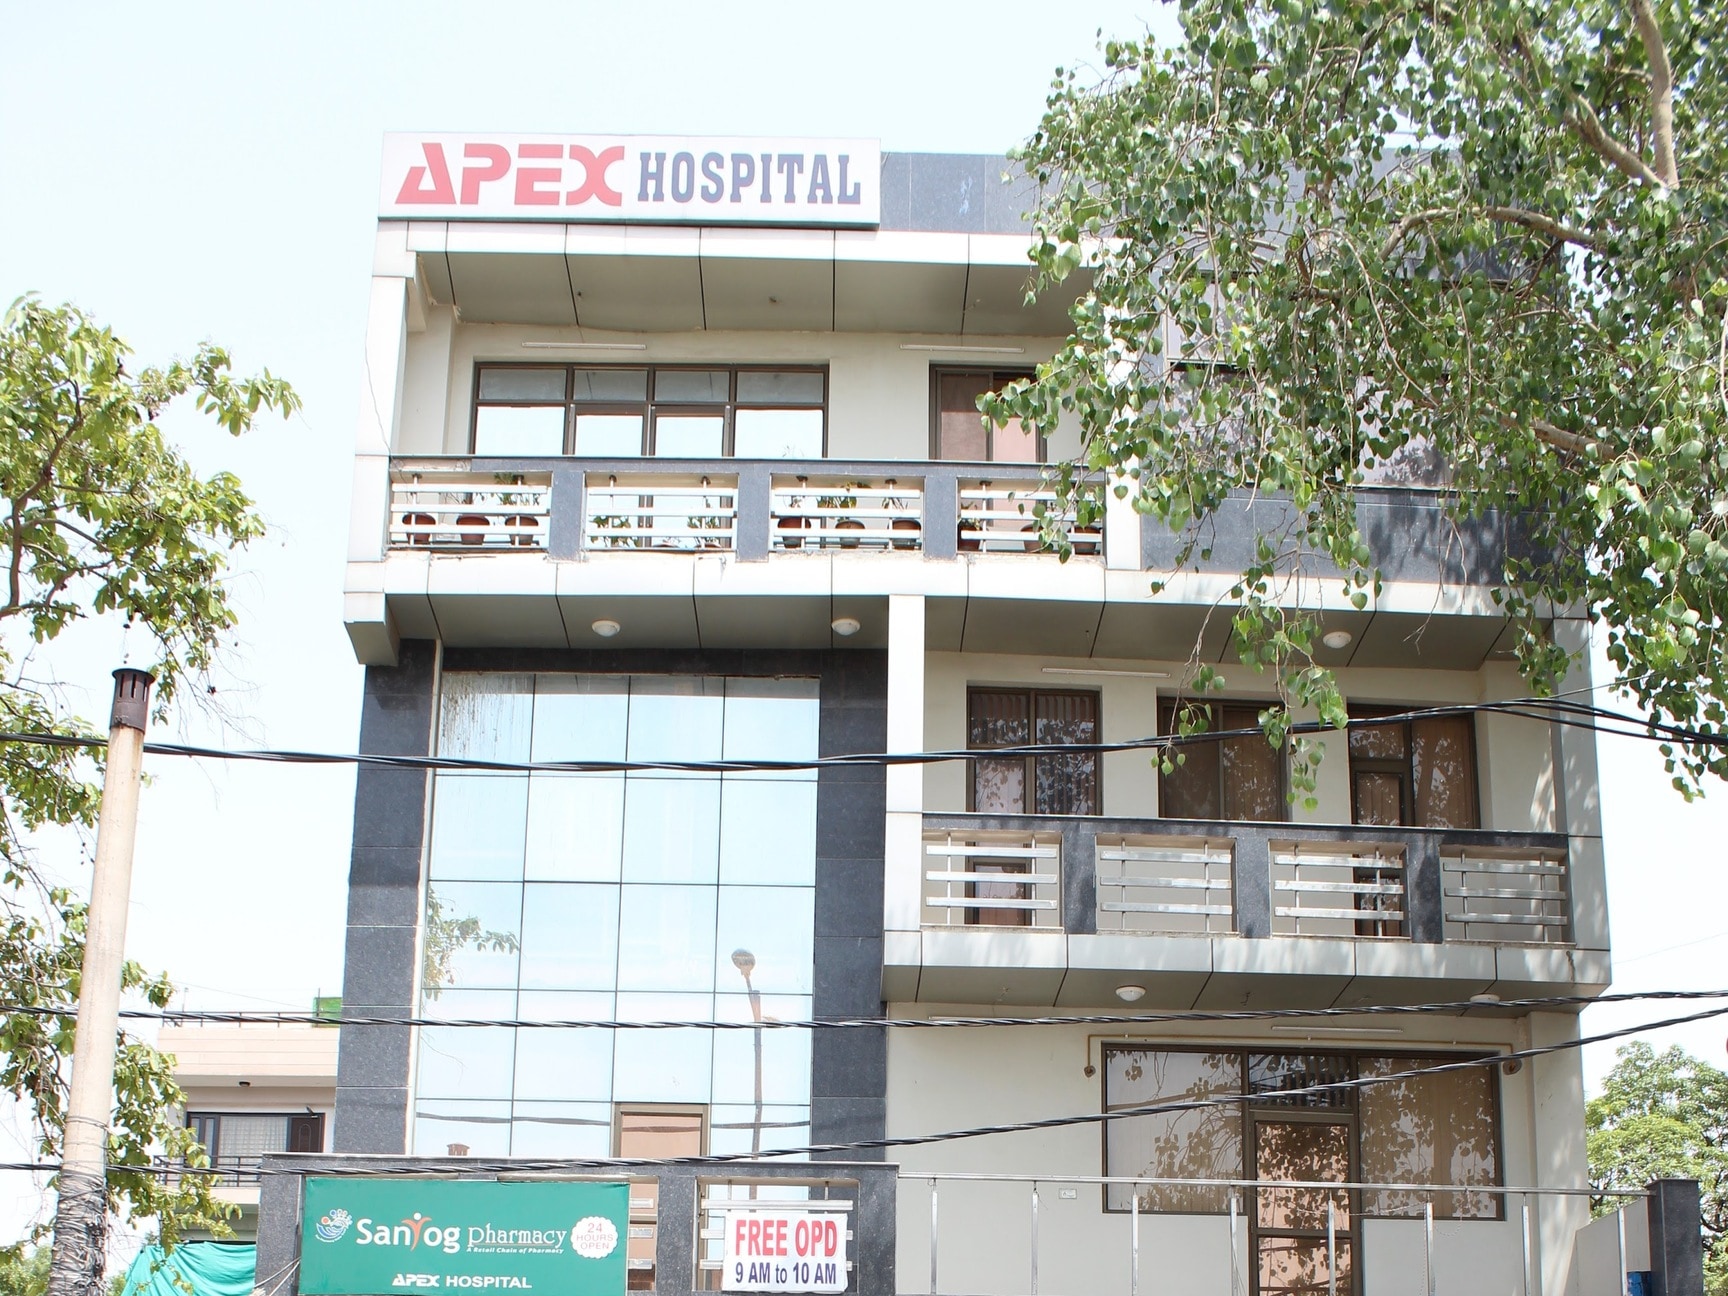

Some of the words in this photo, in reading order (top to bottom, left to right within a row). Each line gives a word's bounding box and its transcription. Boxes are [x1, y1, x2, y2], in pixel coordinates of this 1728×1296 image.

[395, 142, 625, 206] APEX
[637, 151, 861, 205] HOSPITAL
[467, 1222, 567, 1248] pharmacy
[587, 1222, 603, 1233] 24
[576, 1233, 614, 1242] HOURS
[735, 1219, 789, 1258] FREE
[795, 1219, 838, 1257] OPD
[497, 1247, 517, 1255] Chain
[580, 1241, 610, 1250] OPEN
[392, 1273, 440, 1287] APEX
[446, 1275, 532, 1288] HOSPITAL
[735, 1262, 744, 1283] 9
[749, 1262, 771, 1283] AM
[774, 1262, 788, 1283] to
[792, 1263, 808, 1284] 10
[813, 1263, 837, 1285] AM
